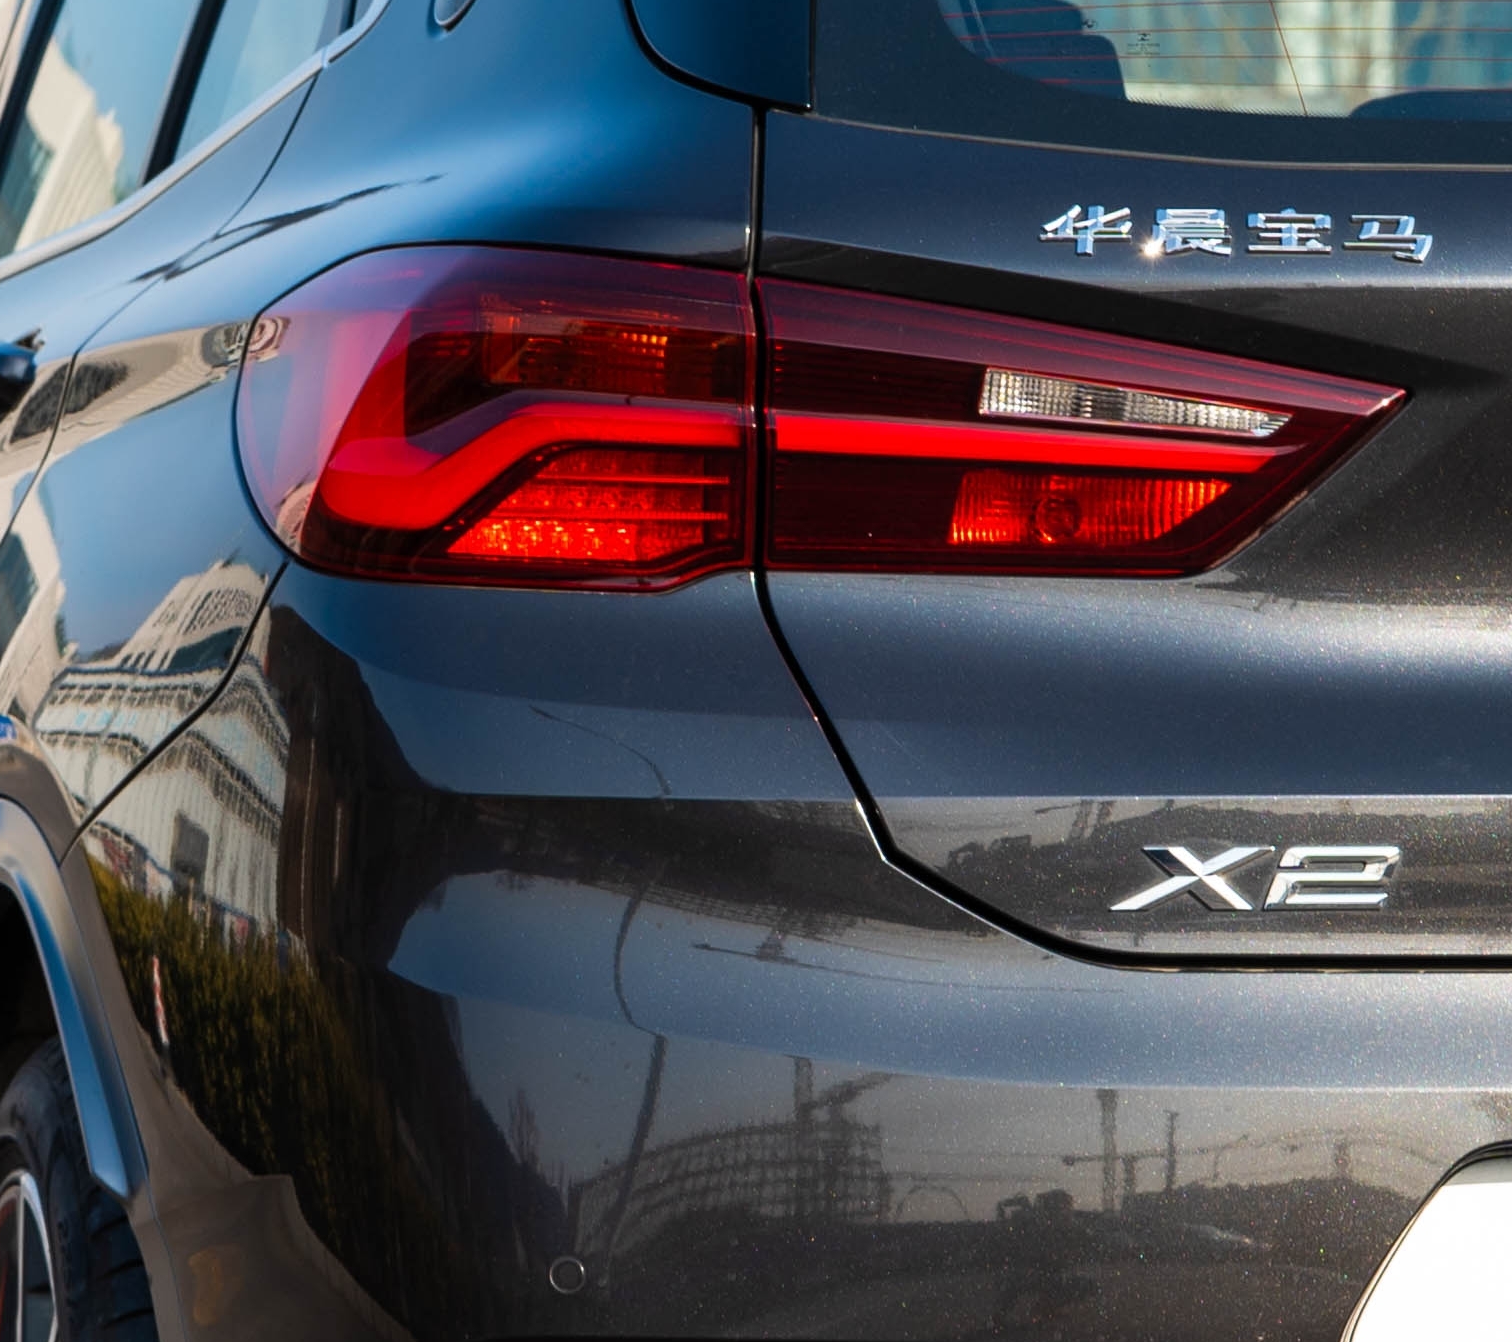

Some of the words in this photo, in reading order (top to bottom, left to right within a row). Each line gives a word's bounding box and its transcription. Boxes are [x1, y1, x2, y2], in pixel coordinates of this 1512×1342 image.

[1039, 204, 1433, 263] 华晨宝马
[1109, 845, 1401, 911] X2
